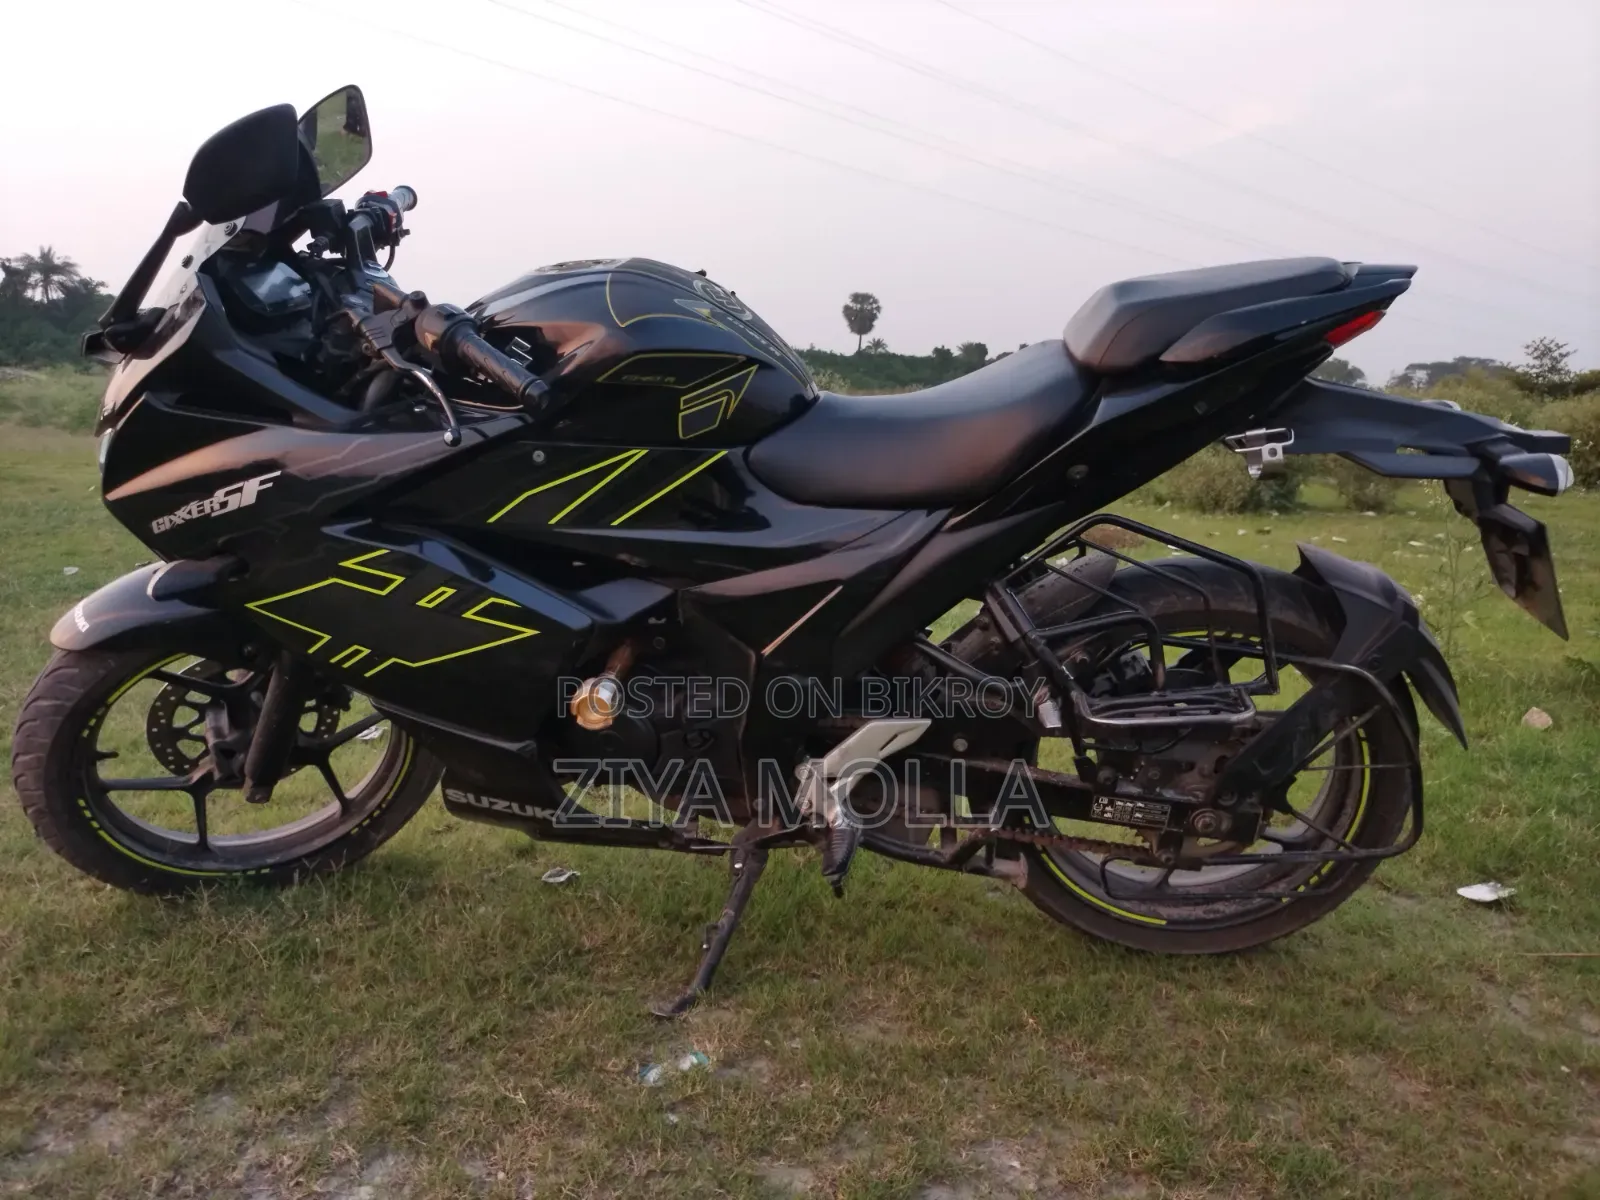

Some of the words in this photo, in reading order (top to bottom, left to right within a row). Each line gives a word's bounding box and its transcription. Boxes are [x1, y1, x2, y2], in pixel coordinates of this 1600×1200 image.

[151, 496, 221, 535] GIXXER
[211, 470, 282, 518] SF
[74, 601, 90, 633] UZUKI
